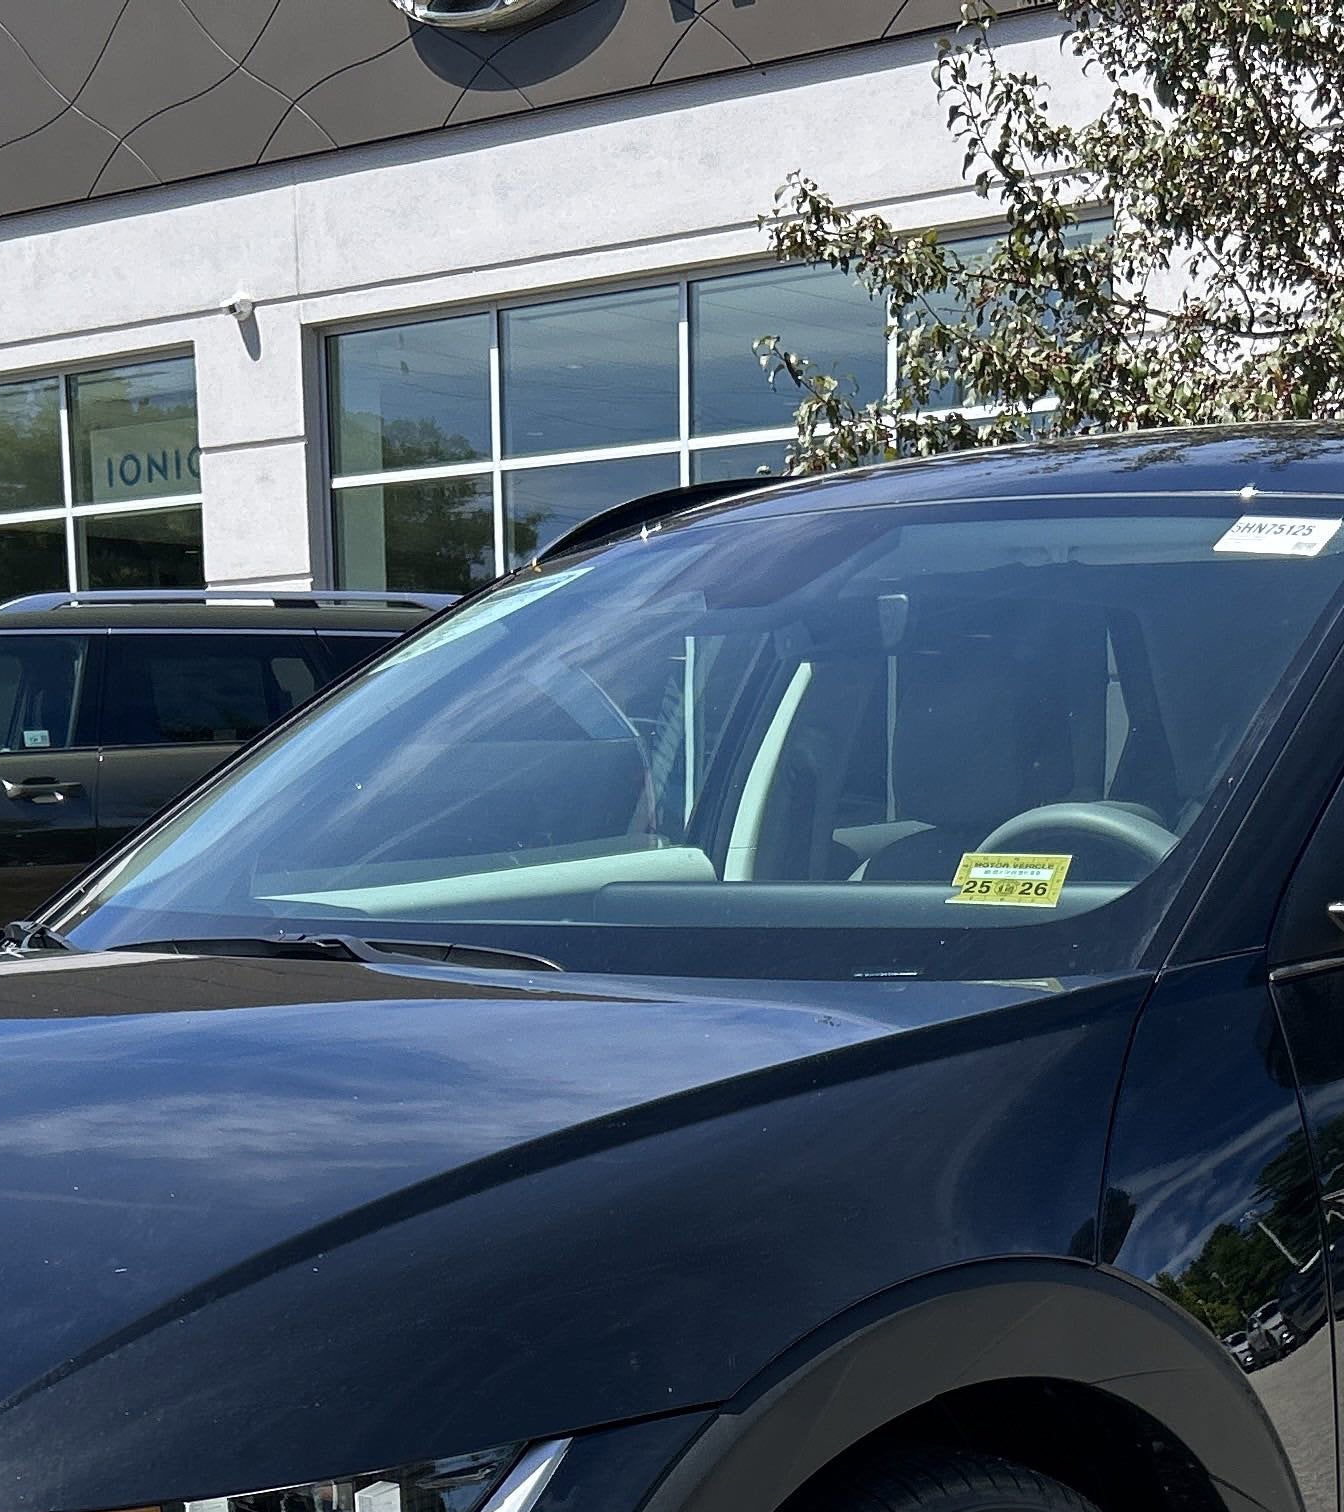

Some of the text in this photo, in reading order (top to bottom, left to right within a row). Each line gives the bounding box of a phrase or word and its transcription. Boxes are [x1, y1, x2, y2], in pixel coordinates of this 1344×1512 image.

[974, 861, 1055, 870] MOTOR VEHICLE
[962, 880, 992, 894] 25
[1018, 881, 1048, 896] 26
